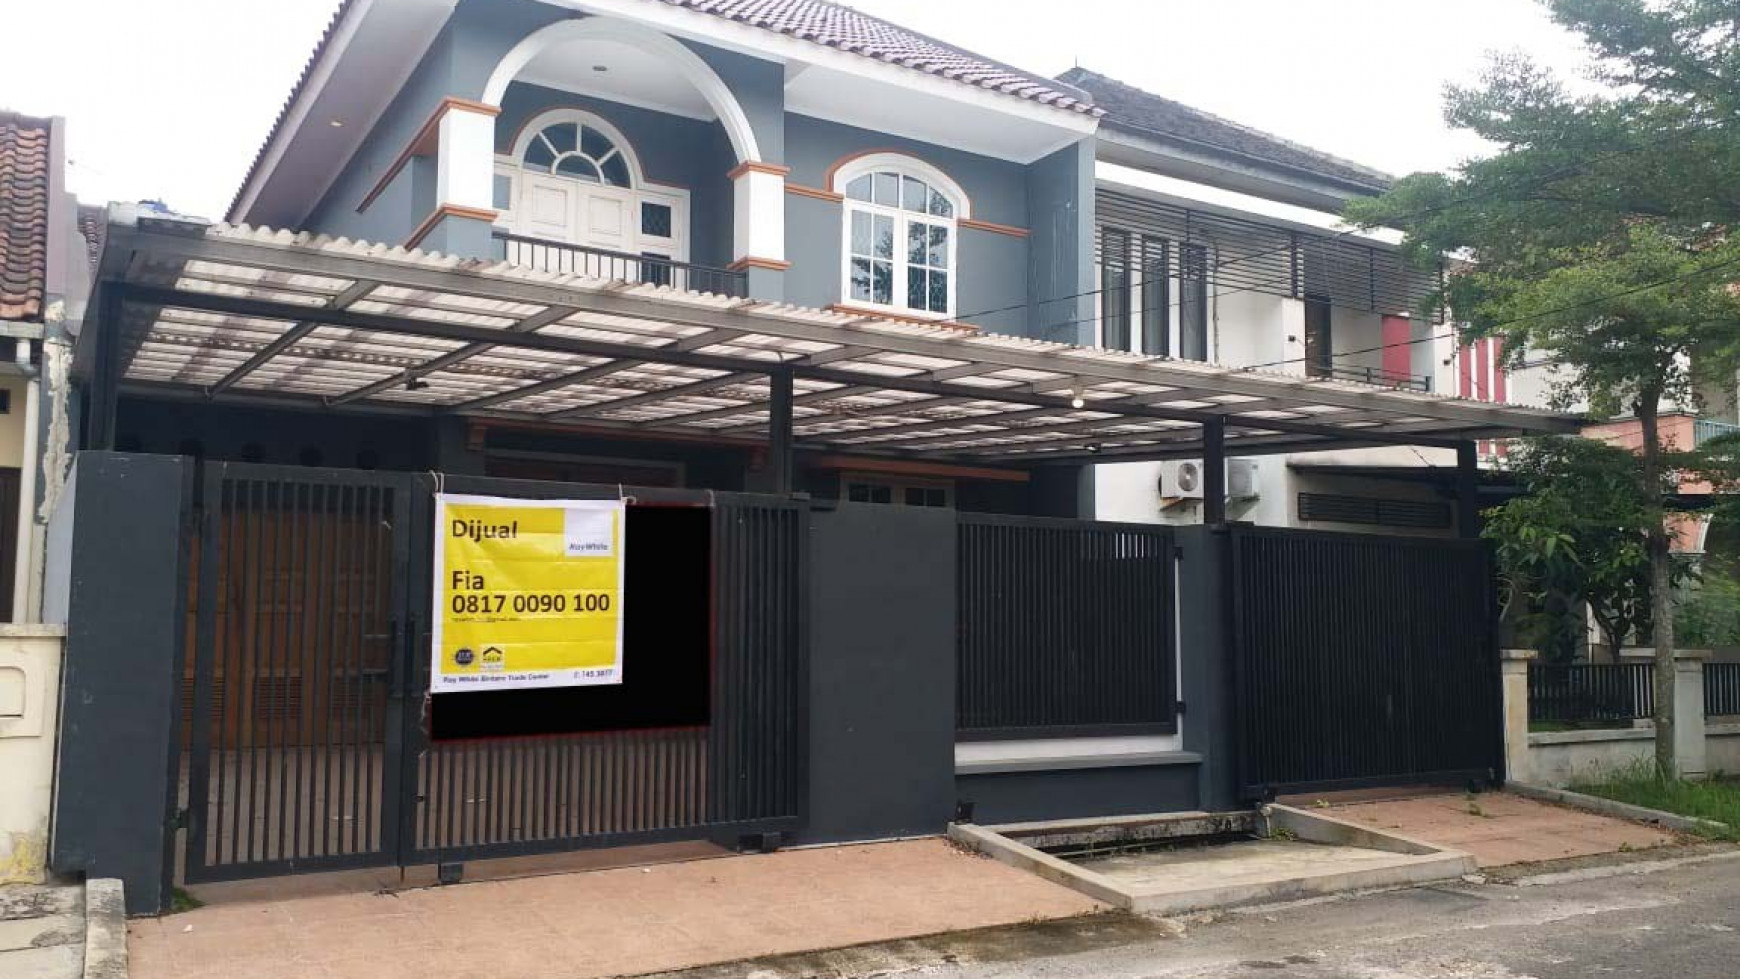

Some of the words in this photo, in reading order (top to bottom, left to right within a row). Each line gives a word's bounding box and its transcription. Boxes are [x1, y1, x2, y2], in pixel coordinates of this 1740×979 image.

[452, 519, 518, 542] Dijual
[452, 570, 485, 590] Fia
[452, 594, 507, 613] 0817
[513, 594, 566, 613] 0090
[573, 593, 610, 612] 100
